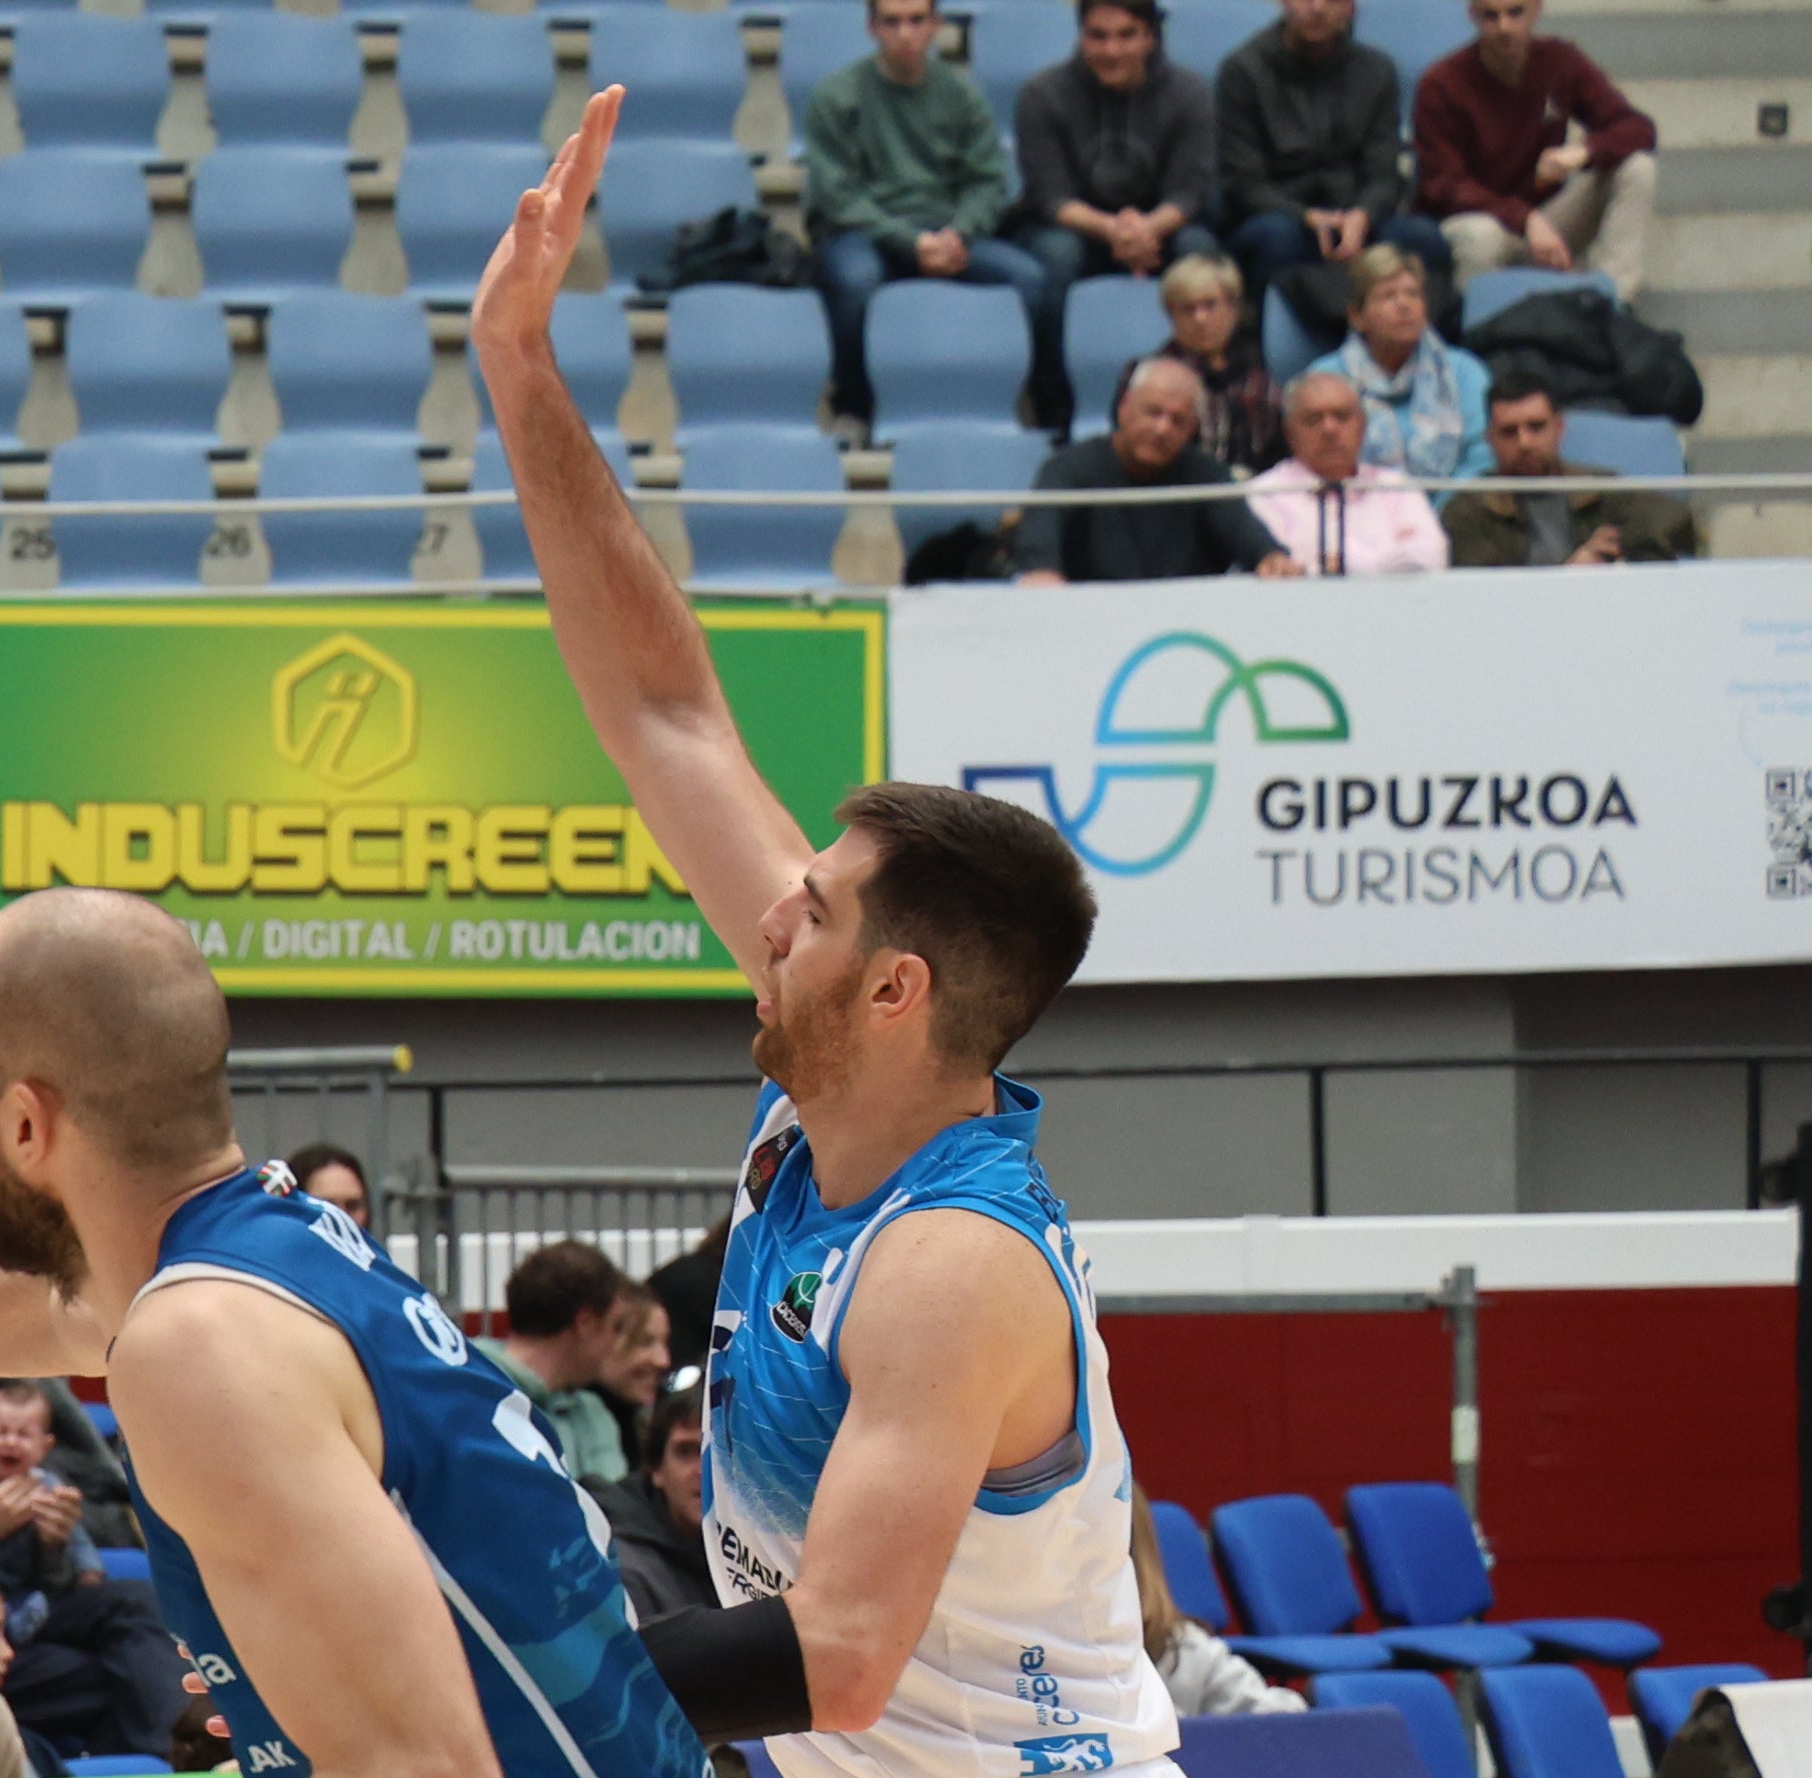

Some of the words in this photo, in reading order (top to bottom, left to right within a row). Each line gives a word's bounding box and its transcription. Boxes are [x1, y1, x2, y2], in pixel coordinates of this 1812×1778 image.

[9, 526, 54, 560] 25
[1256, 773, 1638, 831] GIPUZKOA
[1257, 847, 1627, 906] TURISMOA
[264, 919, 411, 960] DIGITAL
[449, 919, 701, 960] ROTULACION
